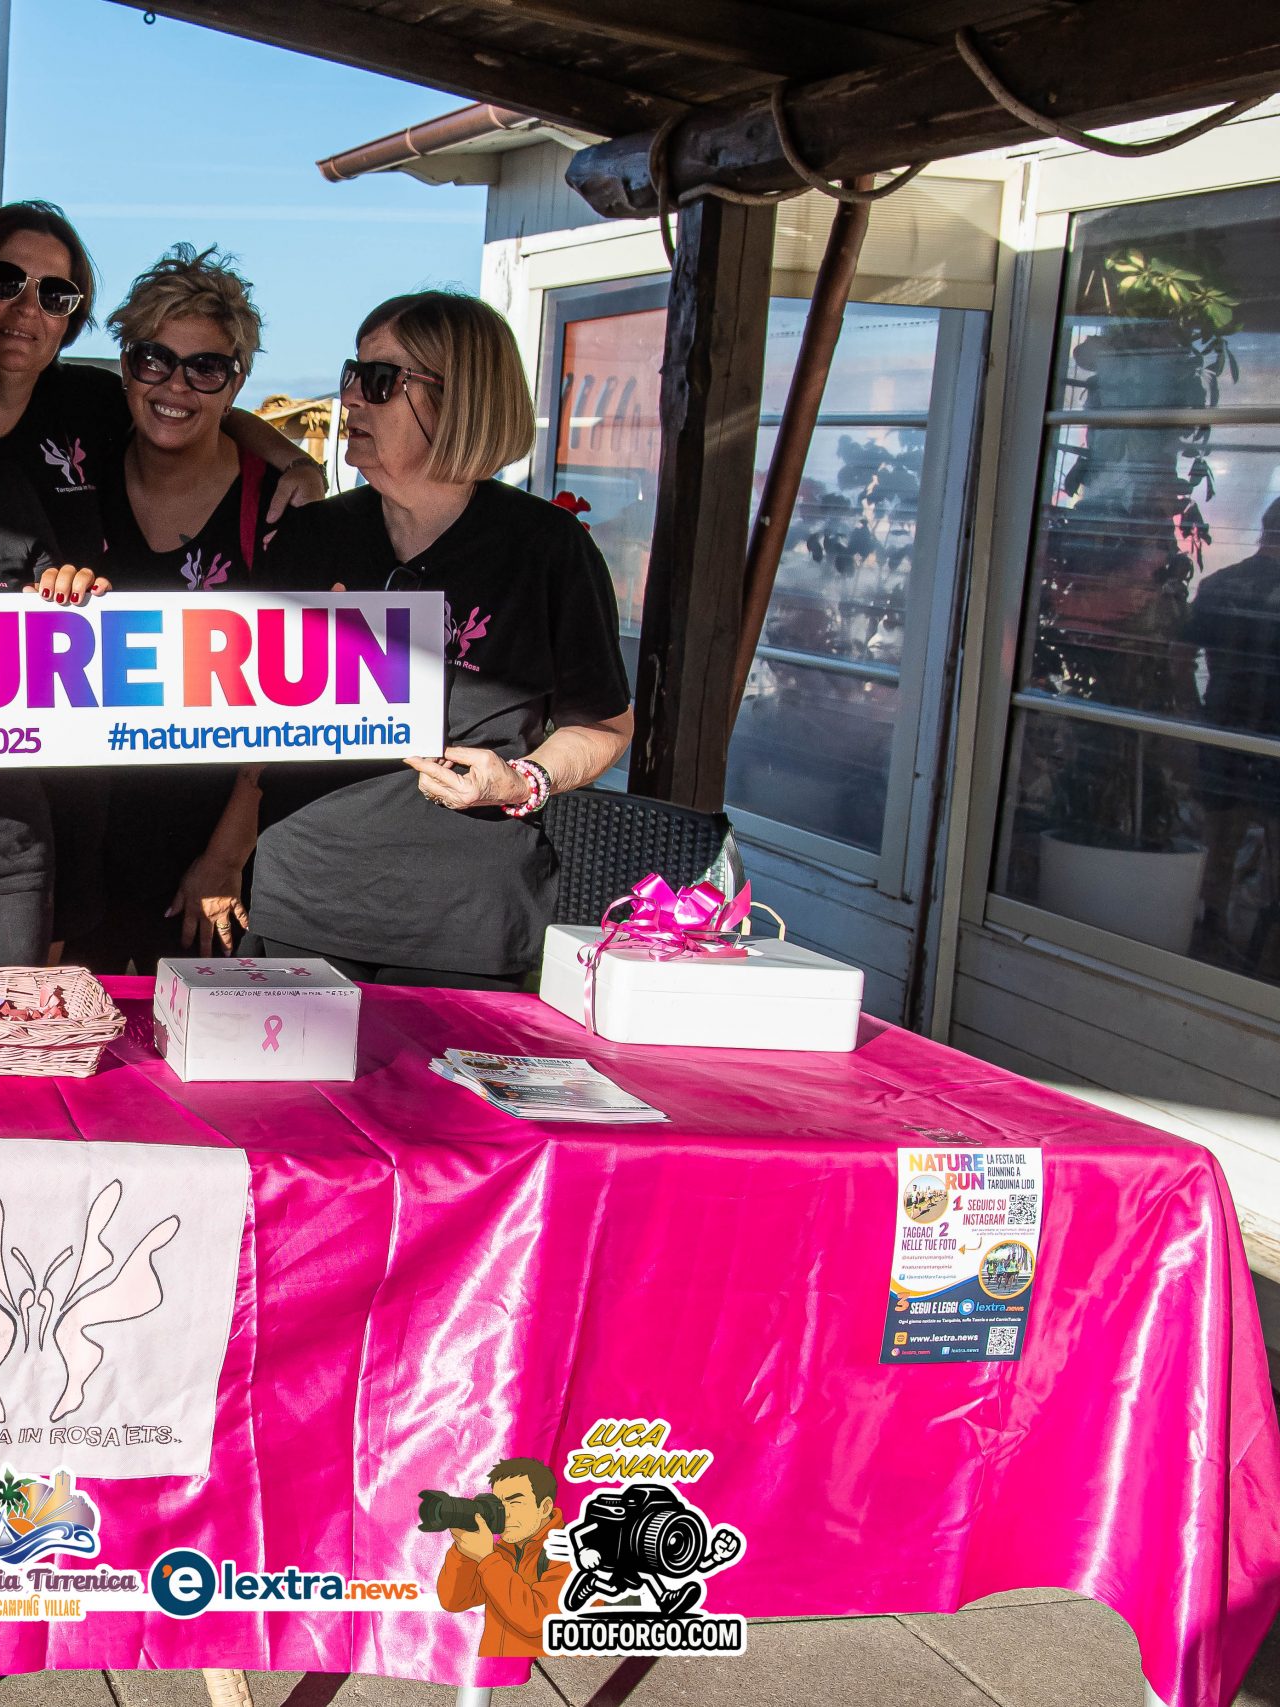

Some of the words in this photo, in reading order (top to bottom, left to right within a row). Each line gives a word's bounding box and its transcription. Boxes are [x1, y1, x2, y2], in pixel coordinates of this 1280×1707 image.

[182, 608, 411, 707] RUN
[462, 661, 480, 672] Rosa
[107, 716, 411, 755] #natureruntarquinia
[909, 1153, 984, 1172] NATURE
[986, 1154, 995, 1164] LA
[996, 1154, 1014, 1164] FESTA
[1015, 1154, 1026, 1164] DEL
[987, 1166, 1015, 1177] RUNNING
[1016, 1166, 1021, 1176] A
[944, 1172, 985, 1190] RUN
[988, 1179, 1020, 1189] TARQUINIA
[1021, 1179, 1034, 1189] LIDO
[953, 1195, 964, 1211] 1
[968, 1199, 996, 1211] SEGUICI
[997, 1199, 1007, 1210] SU
[963, 1213, 1006, 1225] INSTAGRAM
[903, 1226, 934, 1239] TAGGACI
[939, 1222, 950, 1237] 2
[901, 1239, 923, 1251] NELLE
[924, 1239, 937, 1251] TUE
[939, 1239, 957, 1250] FOTO
[895, 1292, 910, 1312] 3
[910, 1302, 932, 1315] SEGUI
[932, 1302, 937, 1313] E
[937, 1301, 958, 1313] LEGGI
[975, 1301, 1025, 1312] lextra.news
[909, 1334, 979, 1343] www.lextra.news
[18, 1426, 42, 1444] IN
[49, 1426, 120, 1448] ROSA
